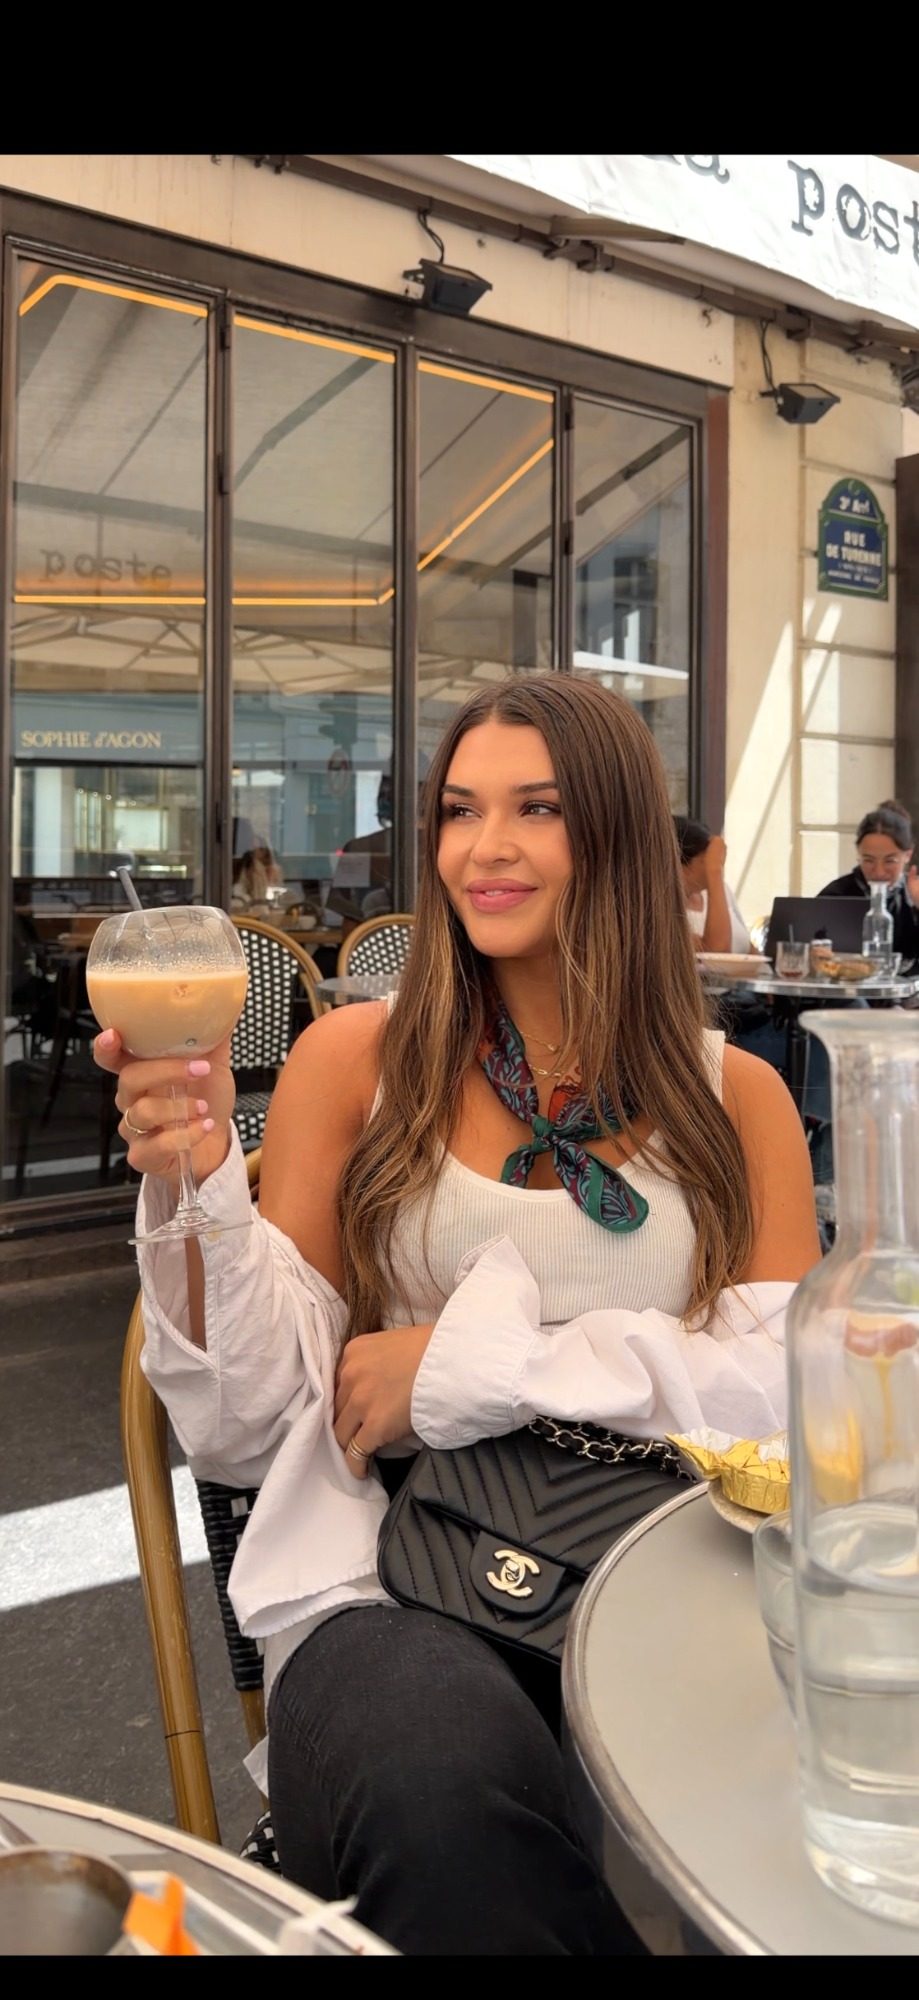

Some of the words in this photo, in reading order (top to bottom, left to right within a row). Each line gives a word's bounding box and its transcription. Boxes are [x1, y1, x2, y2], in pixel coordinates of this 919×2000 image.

[844, 530, 866, 547] RUE
[826, 543, 839, 559] DE
[841, 545, 881, 567] TURENNE
[39, 549, 172, 590] poste
[21, 730, 91, 748] SOPHIE
